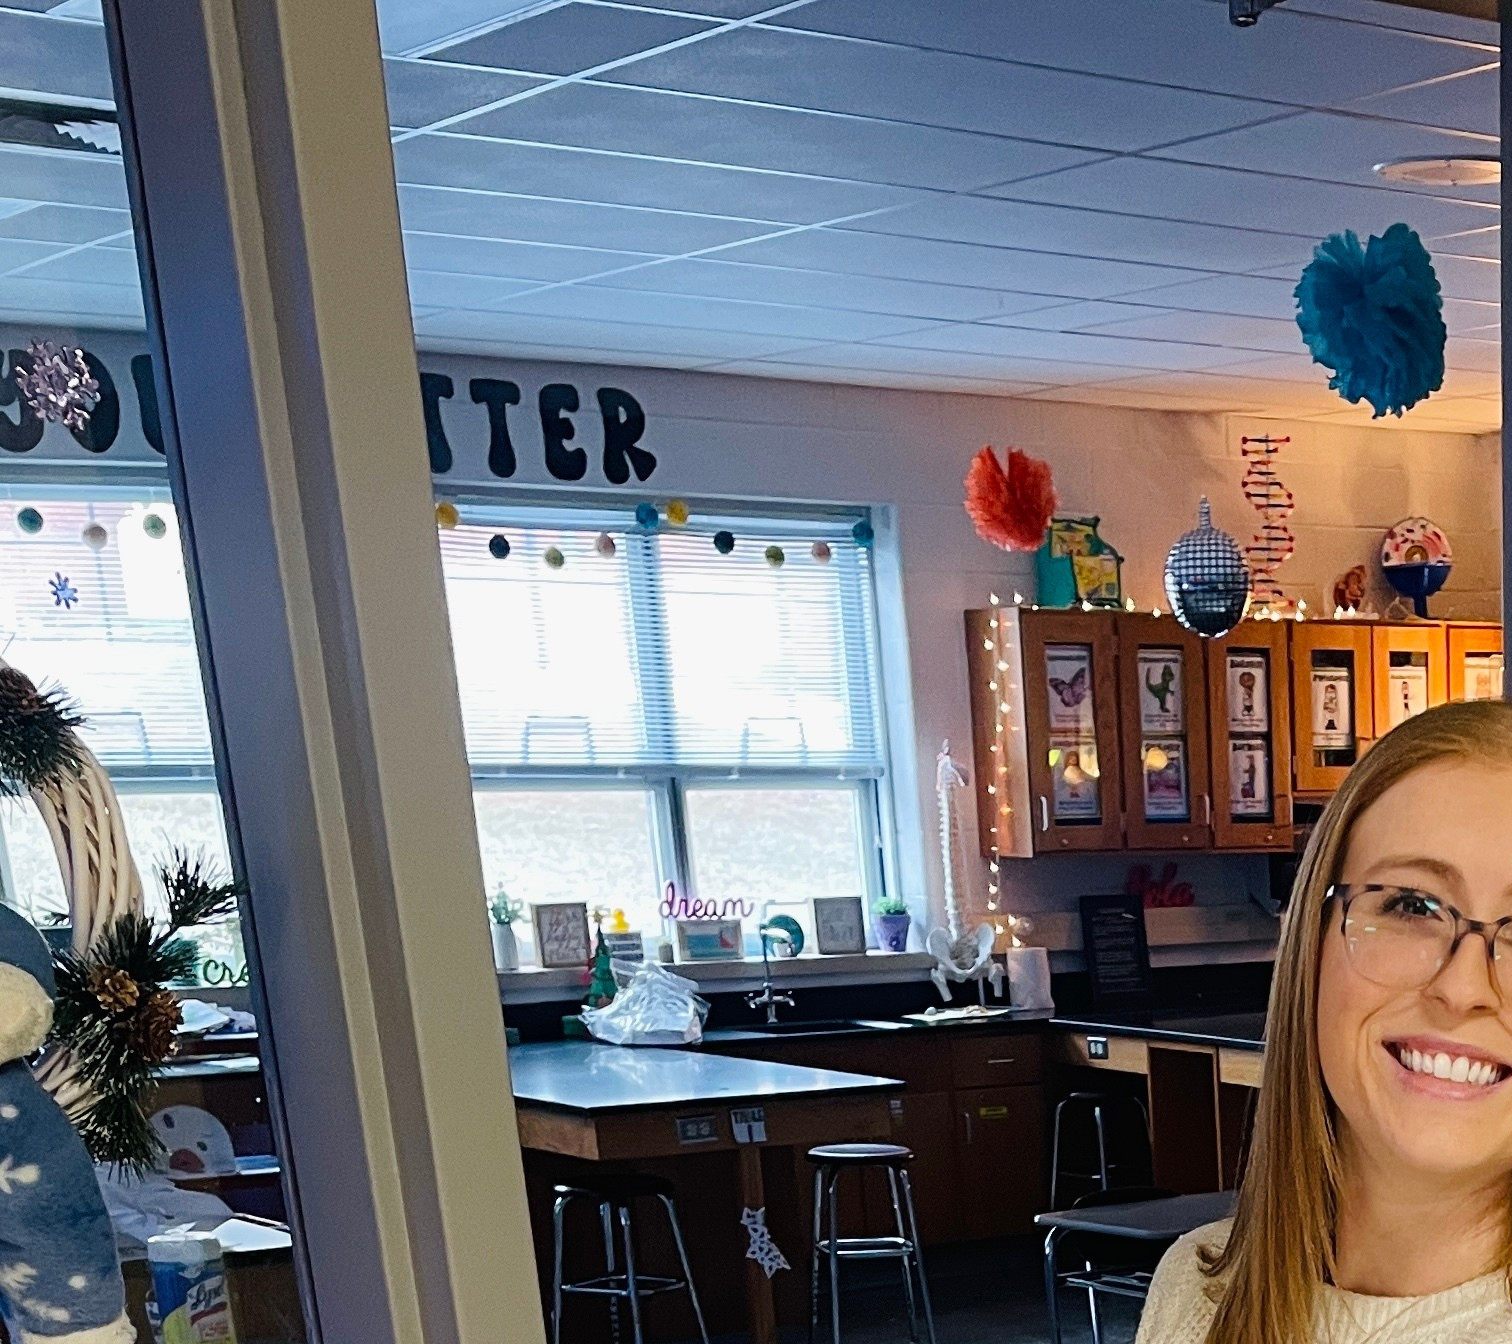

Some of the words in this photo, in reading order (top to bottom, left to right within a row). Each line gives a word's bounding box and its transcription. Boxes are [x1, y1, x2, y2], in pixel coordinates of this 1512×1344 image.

[0, 347, 165, 454] YO
[420, 373, 657, 485] TTER
[659, 882, 754, 918] dream
